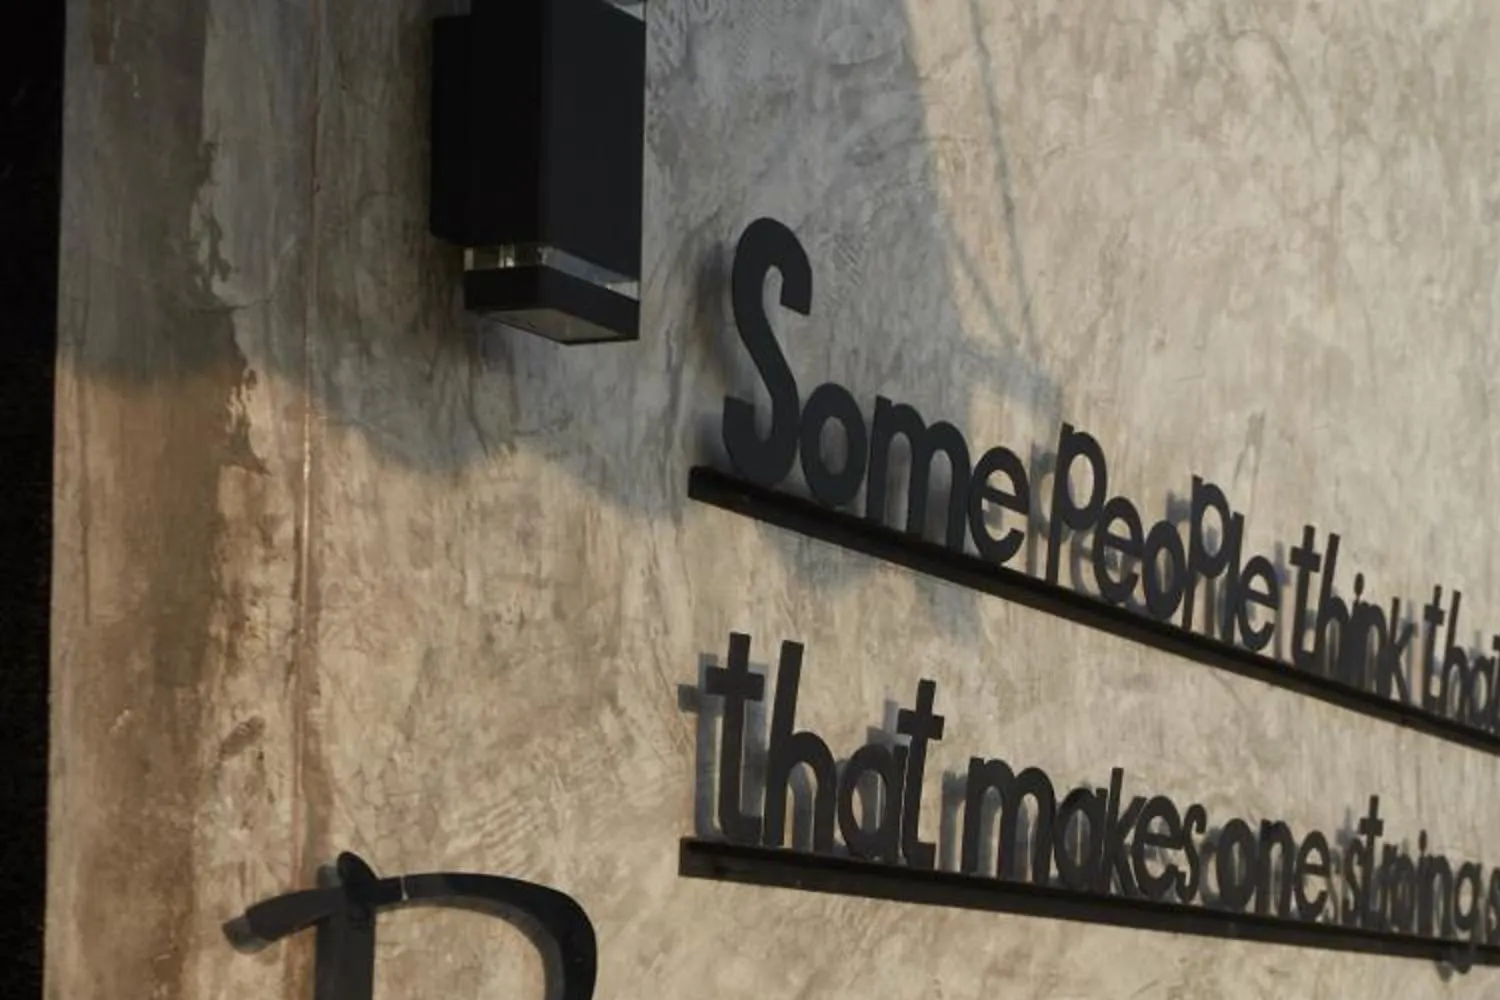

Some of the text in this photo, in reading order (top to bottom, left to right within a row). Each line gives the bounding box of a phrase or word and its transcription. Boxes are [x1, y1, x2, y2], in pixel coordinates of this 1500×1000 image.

[722, 217, 1030, 565] Some
[1290, 524, 1411, 702] think
[704, 632, 945, 868] that
[961, 766, 1208, 904] makes
[1215, 817, 1331, 921] one
